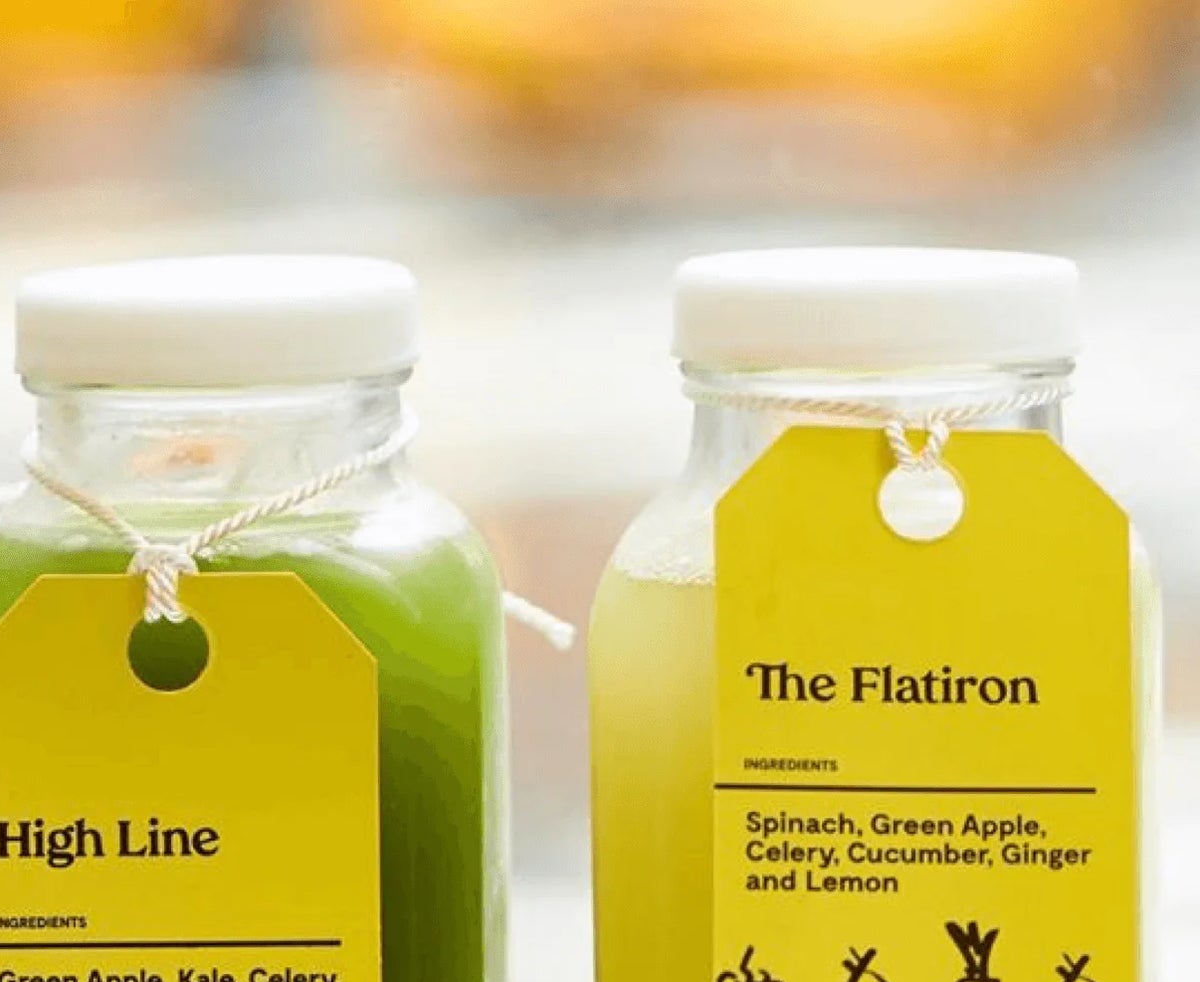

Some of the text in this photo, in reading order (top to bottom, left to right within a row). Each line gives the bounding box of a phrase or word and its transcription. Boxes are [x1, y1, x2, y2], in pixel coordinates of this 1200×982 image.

[746, 662, 1039, 705] The Flatiron
[744, 759, 838, 772] INGREDIENTS
[118, 818, 219, 857] Line
[746, 811, 1047, 840] Spinach, Green Apple,
[746, 840, 1092, 871] Celery, Cucumber, Ginger
[746, 871, 898, 892] and Lemon
